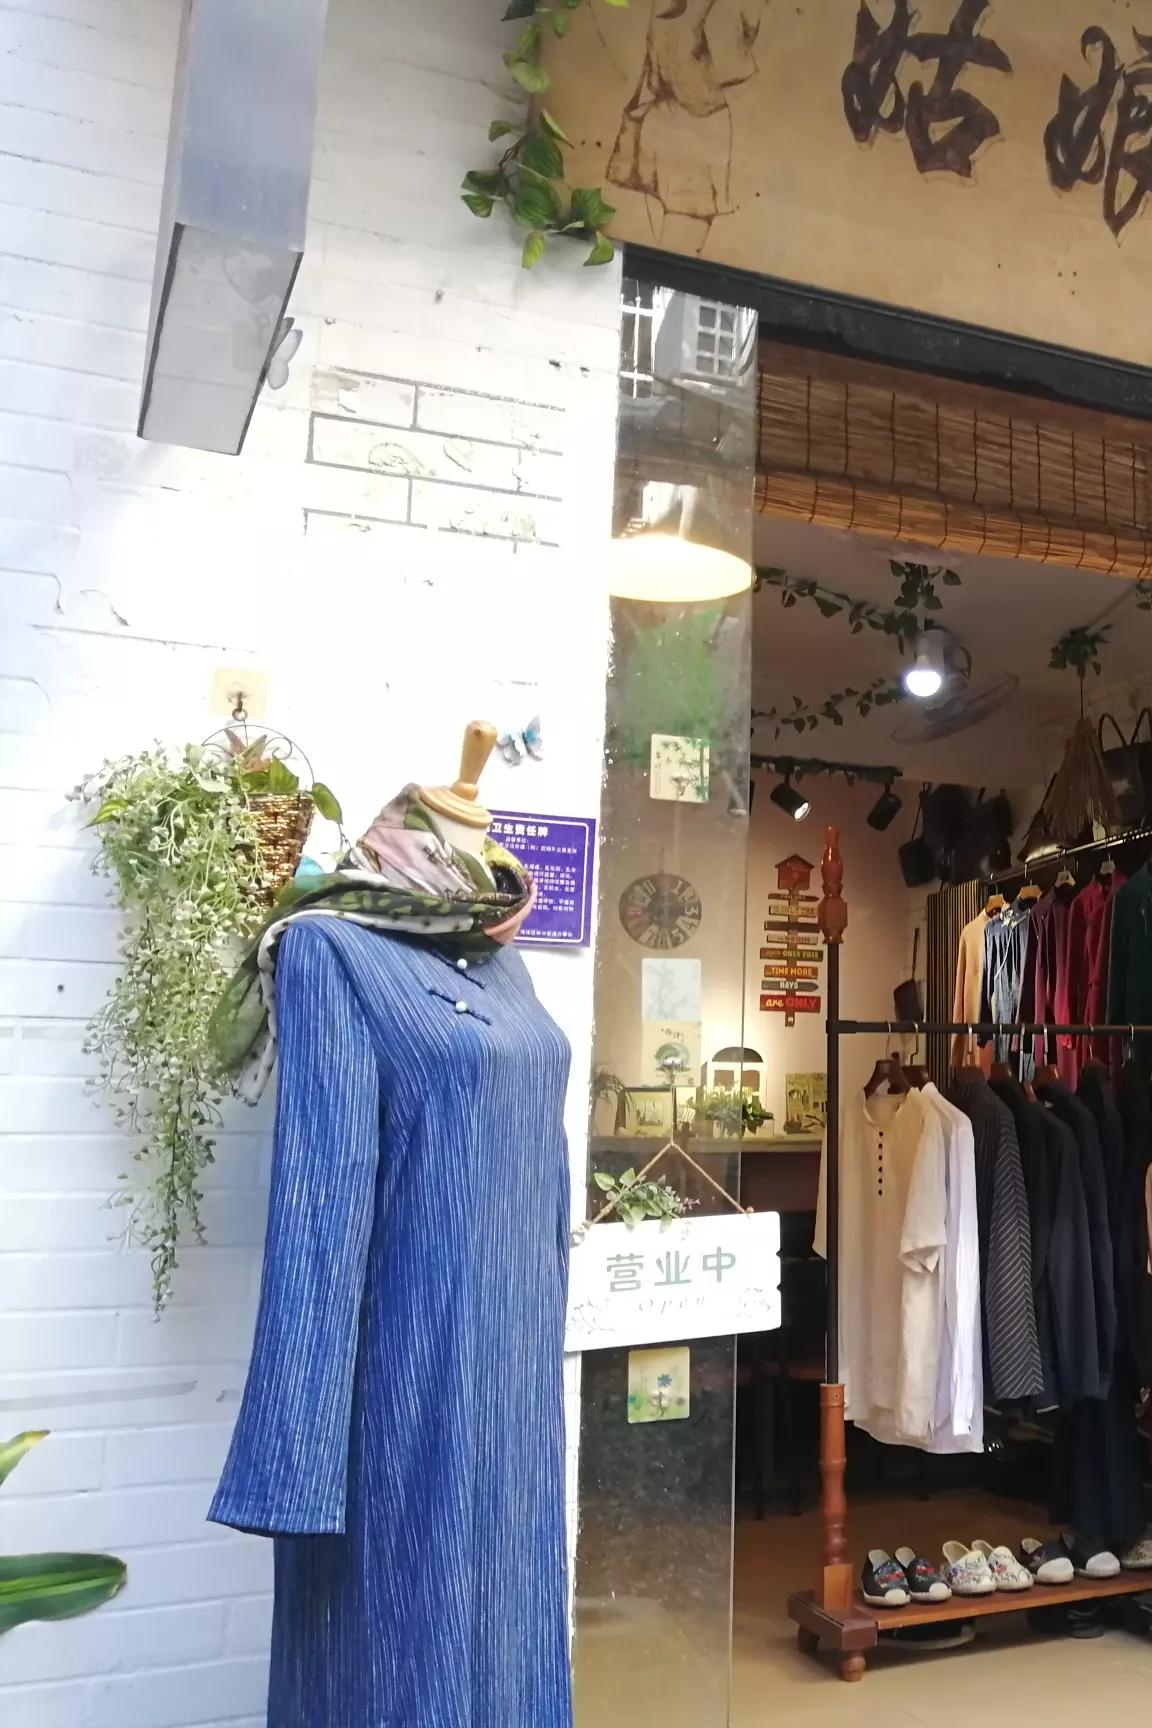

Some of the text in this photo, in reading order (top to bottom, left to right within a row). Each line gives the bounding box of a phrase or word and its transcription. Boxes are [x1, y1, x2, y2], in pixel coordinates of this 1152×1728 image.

[486, 822, 549, 838] 卫生责任牌
[772, 967, 812, 977] TIME MORE
[766, 998, 816, 1008] are ONLY
[606, 1246, 737, 1293] 营业中
